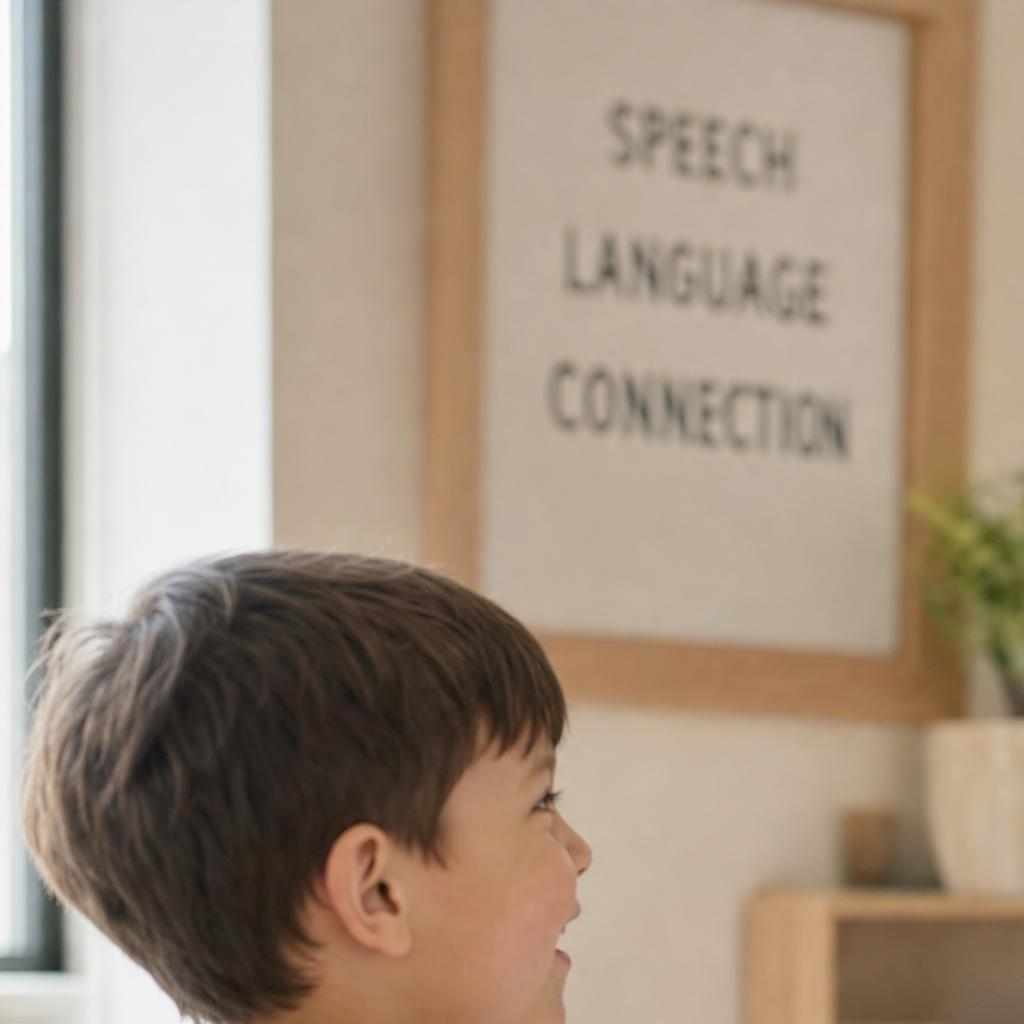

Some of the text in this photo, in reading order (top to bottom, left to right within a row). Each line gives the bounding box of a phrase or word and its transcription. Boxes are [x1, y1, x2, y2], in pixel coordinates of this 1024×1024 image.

[607, 101, 797, 190] SPEECH
[563, 224, 829, 327] LANGUAGE
[547, 361, 851, 462] CONNECTION
